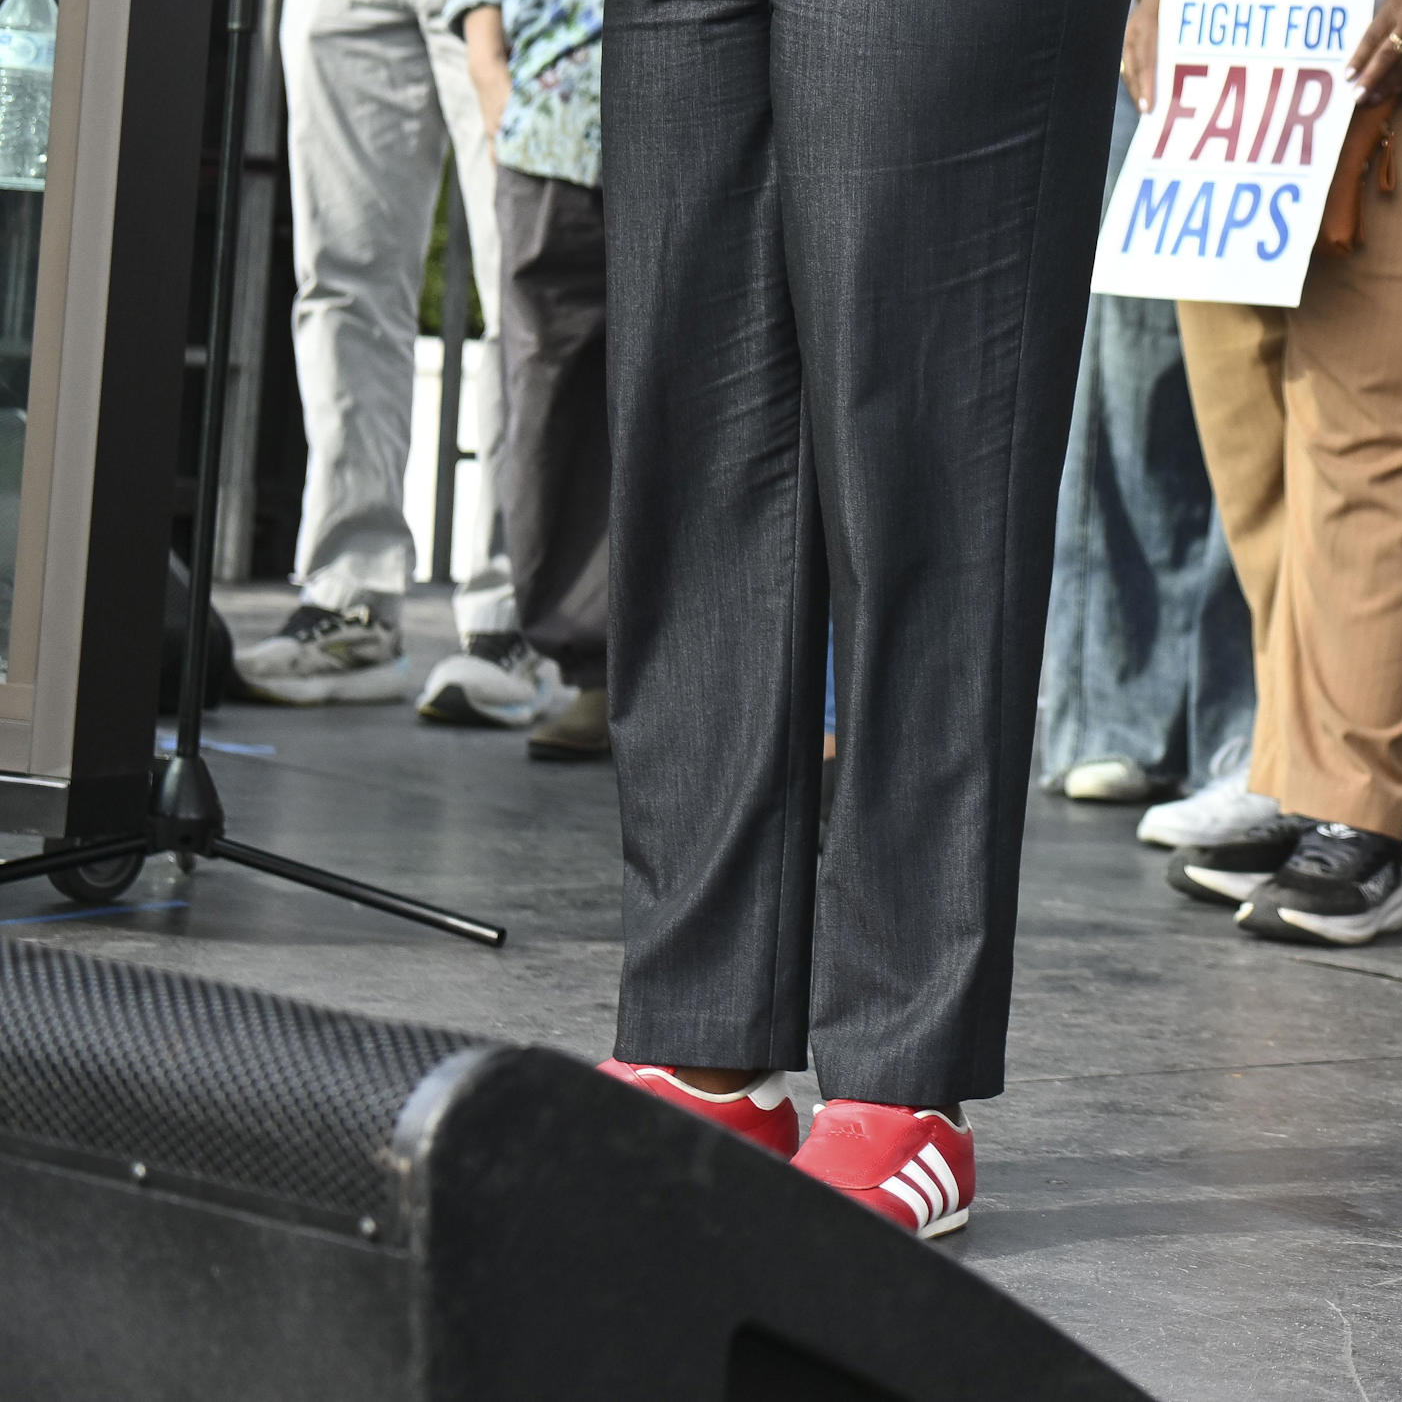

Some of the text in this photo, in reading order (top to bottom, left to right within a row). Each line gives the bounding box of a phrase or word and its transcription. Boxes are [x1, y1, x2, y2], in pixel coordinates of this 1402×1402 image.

[1178, 1, 1347, 51] FIGHT FOR
[1152, 64, 1335, 167] FAIR
[1120, 178, 1300, 263] MAPS
